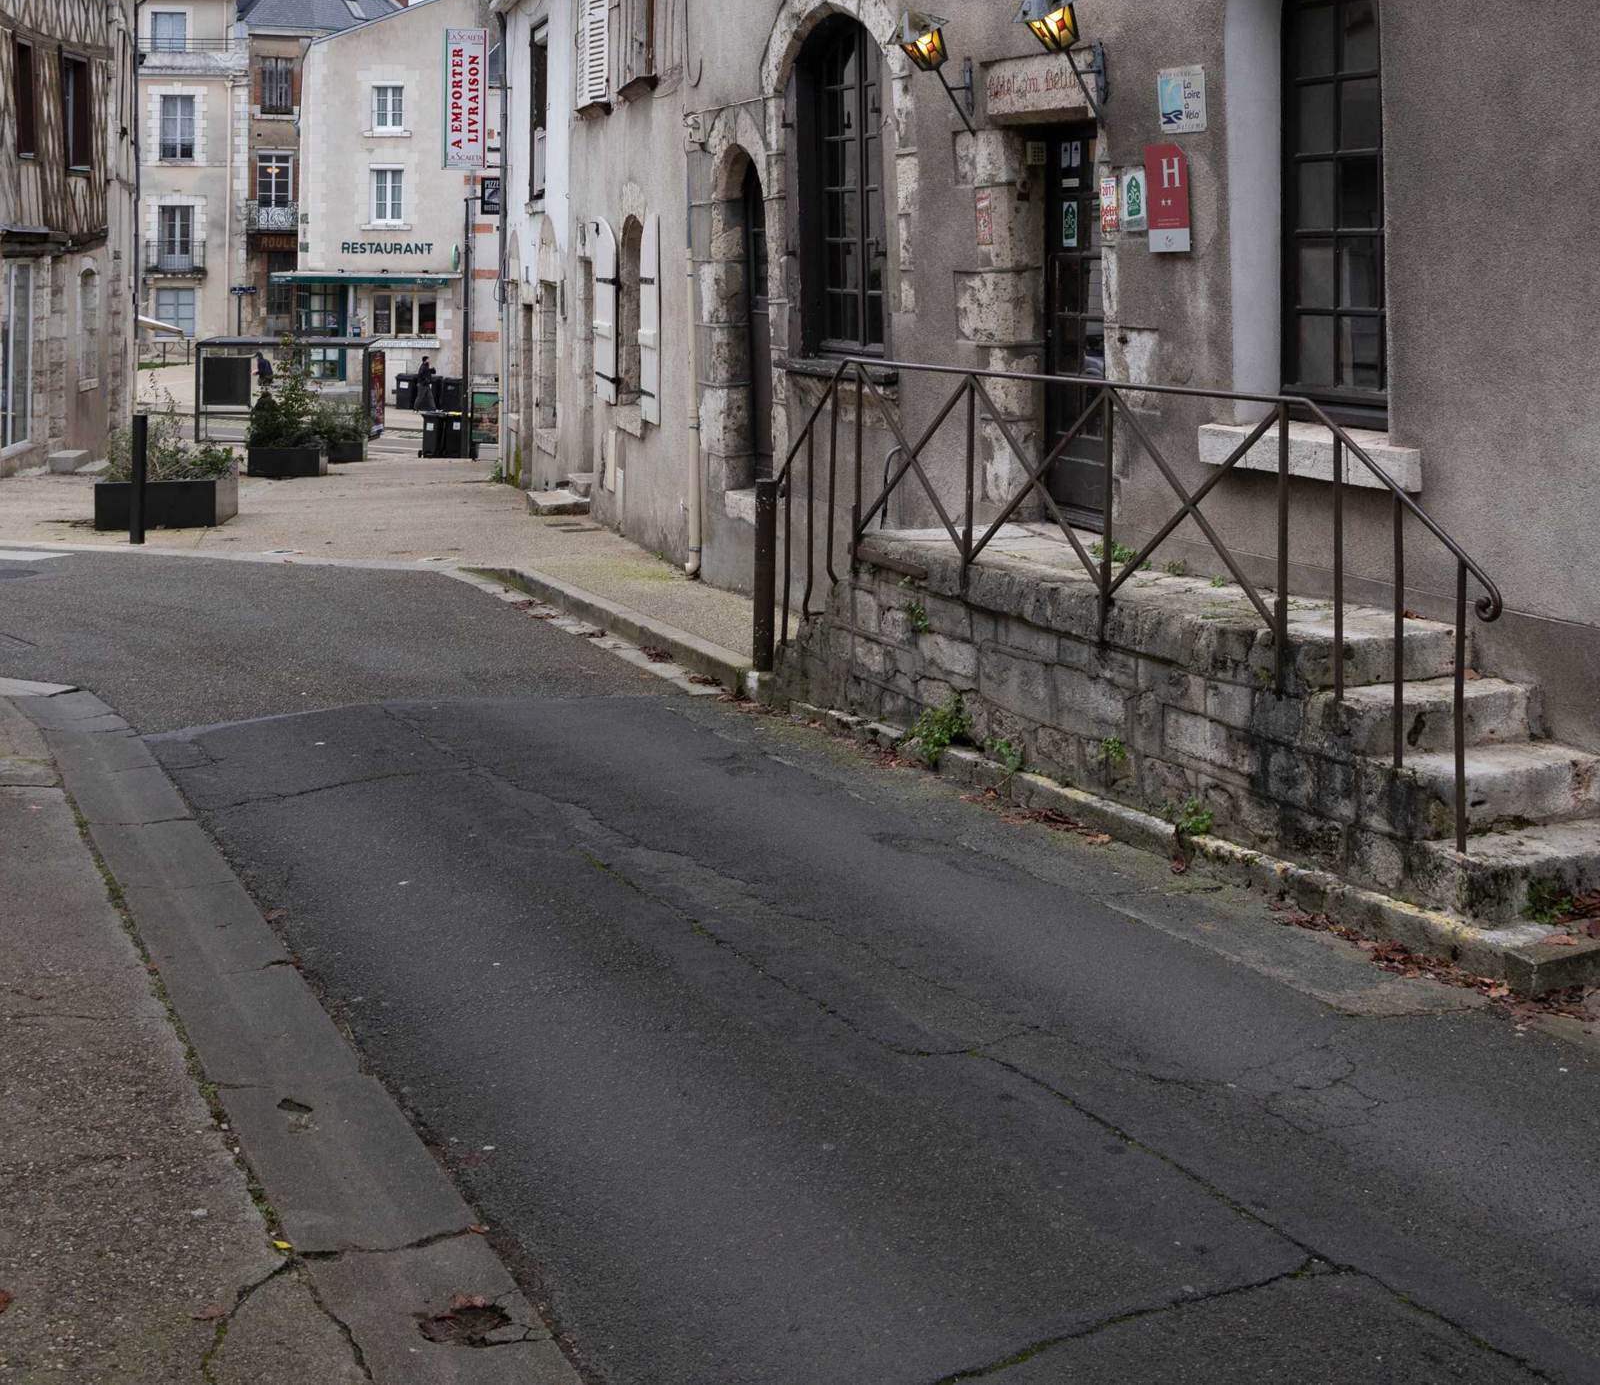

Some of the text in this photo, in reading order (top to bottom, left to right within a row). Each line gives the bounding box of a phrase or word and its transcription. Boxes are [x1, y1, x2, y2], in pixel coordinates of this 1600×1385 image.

[1183, 79, 1192, 89] La
[451, 48, 463, 149] A EMPORTER
[468, 55, 480, 143] LIVRAISON
[1184, 90, 1201, 99] Loire
[1160, 157, 1180, 188] H
[1101, 185, 1115, 196] 2017
[341, 242, 433, 255] RESTAURANT
